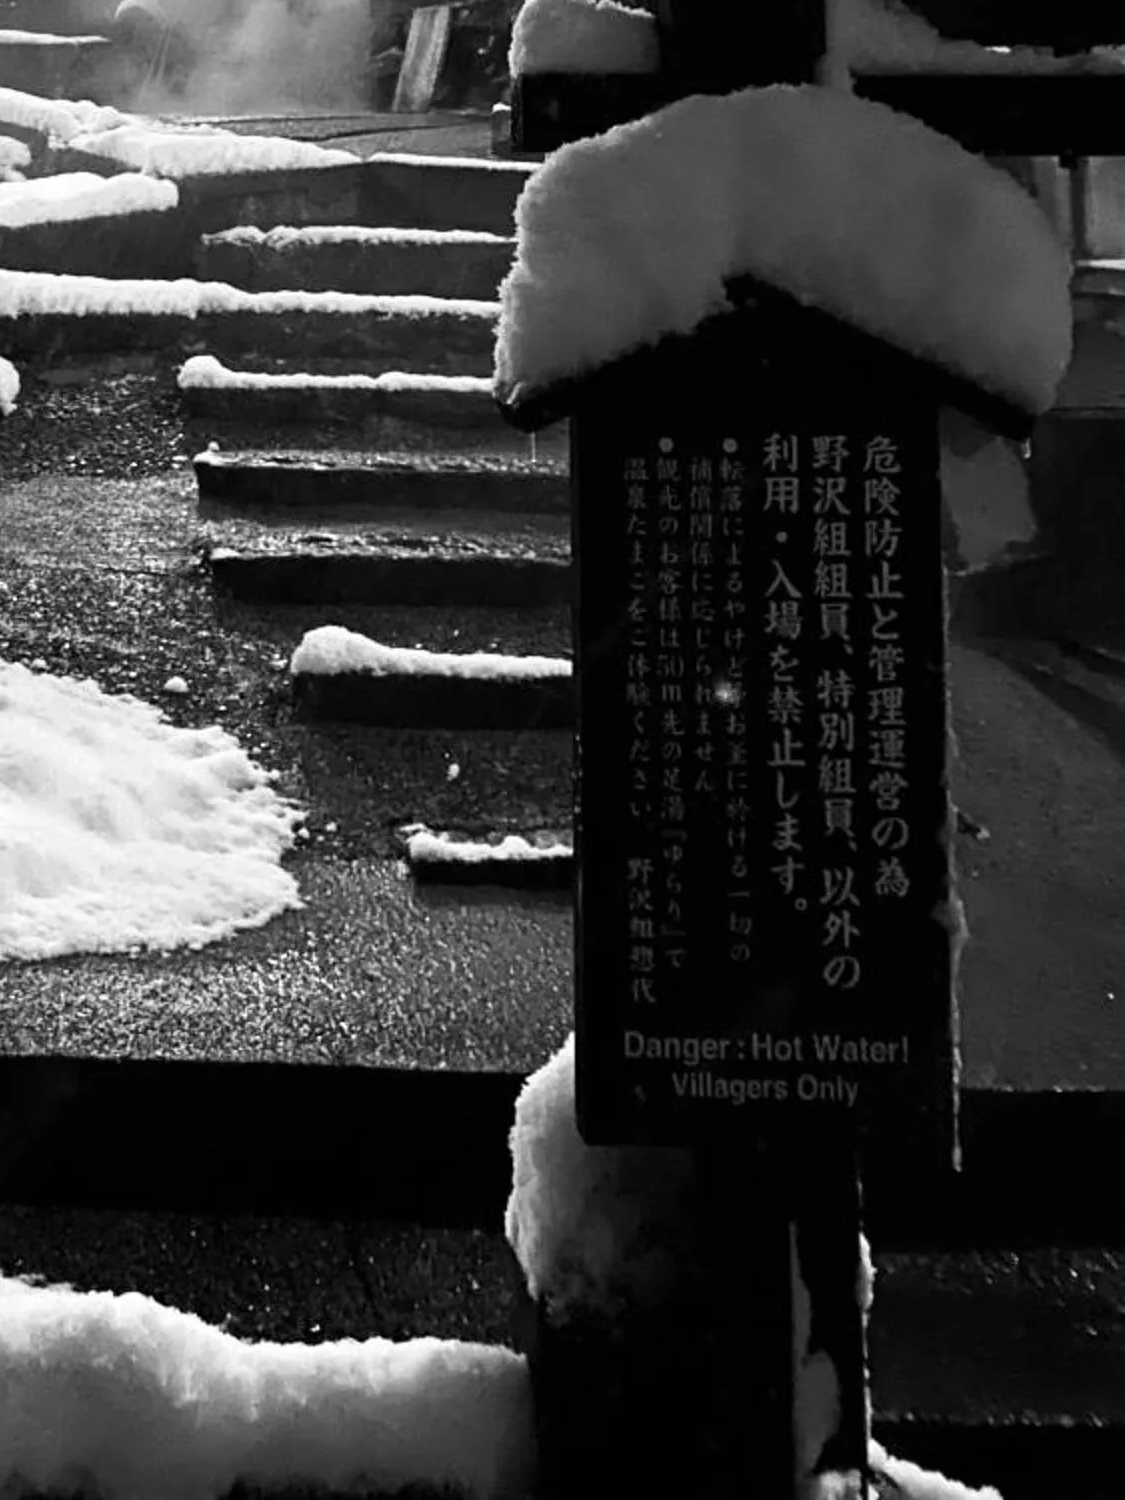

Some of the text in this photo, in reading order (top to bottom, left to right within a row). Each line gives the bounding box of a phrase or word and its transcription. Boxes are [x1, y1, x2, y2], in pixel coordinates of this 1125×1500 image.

[811, 435, 861, 989] 野沢組組員、特別組員、以外の
[863, 435, 910, 898] 危険防止と管理運営の為
[671, 1072, 858, 1107] Villagers Only
[751, 1032, 803, 1062] Hot
[812, 1033, 908, 1063] Water!
